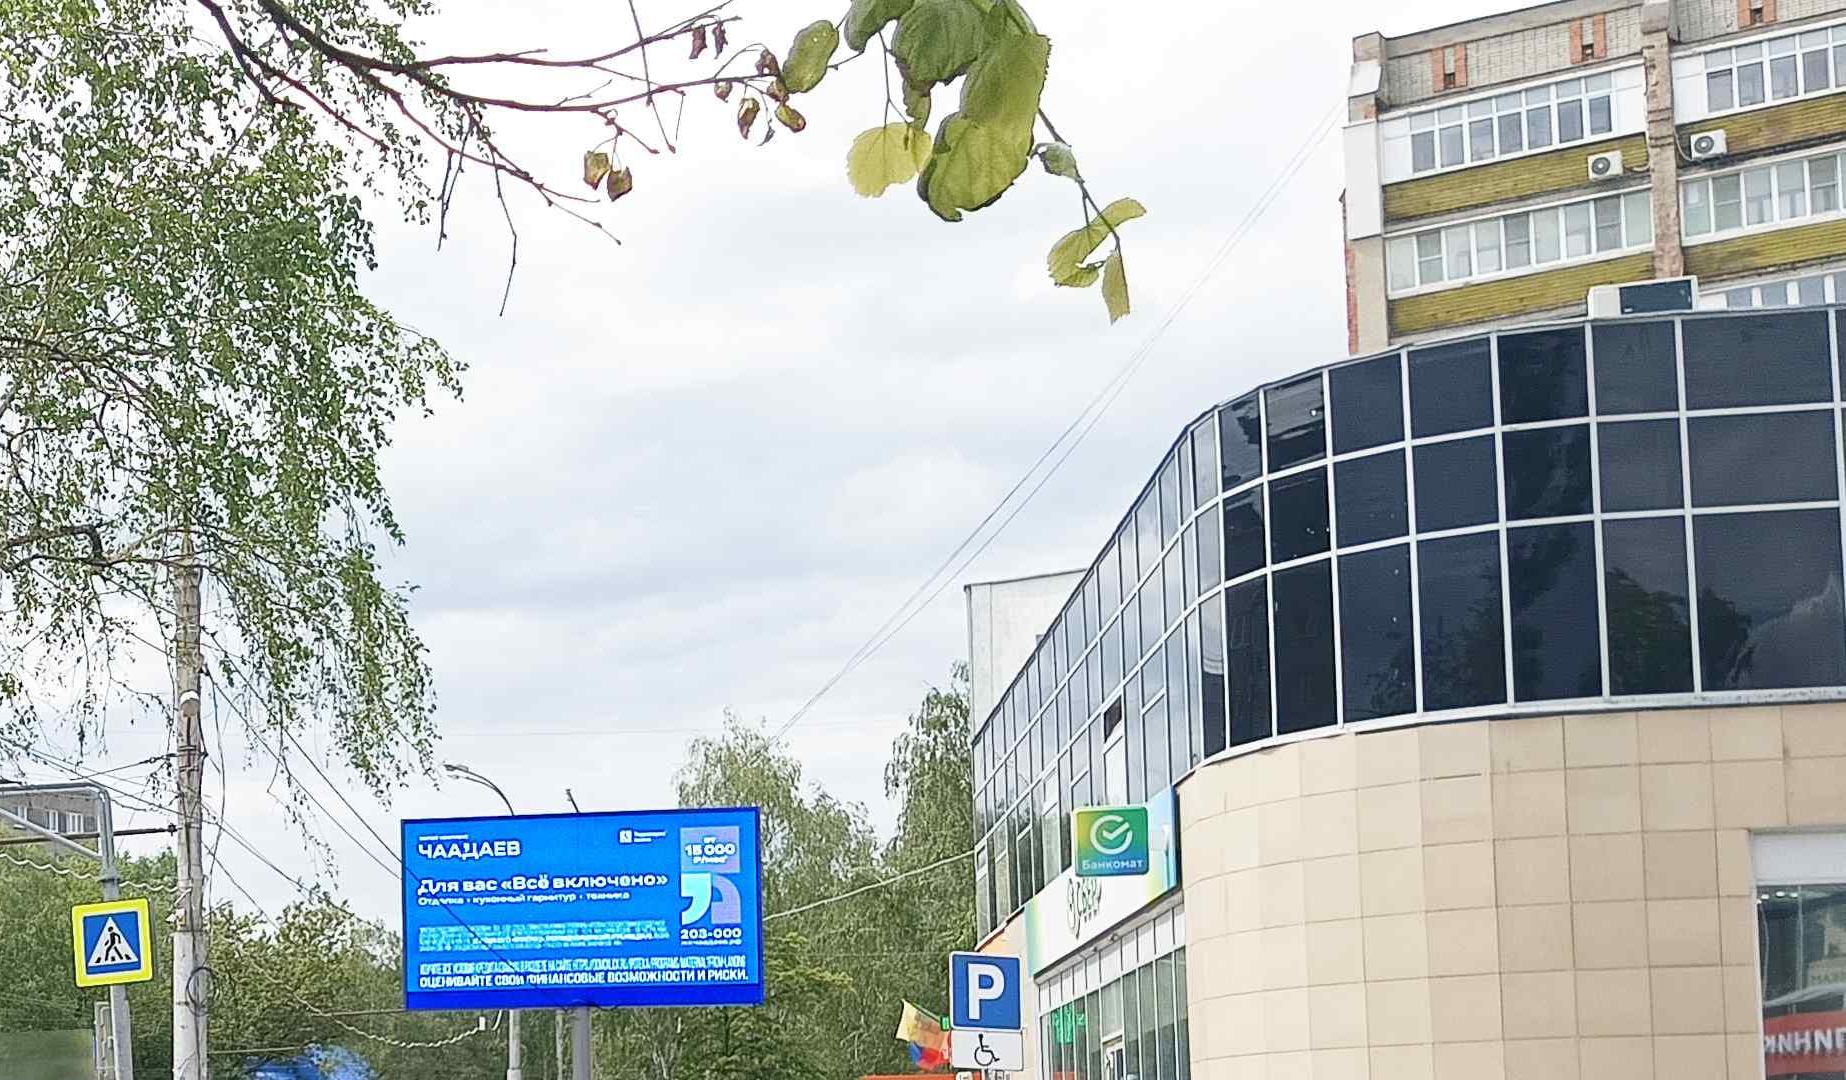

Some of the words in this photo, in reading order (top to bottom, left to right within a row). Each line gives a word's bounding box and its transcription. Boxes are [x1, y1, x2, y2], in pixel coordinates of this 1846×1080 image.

[418, 840, 521, 860] ЧААДАЕВ
[1081, 858, 1143, 871] Банкомат
[417, 879, 459, 896] Для
[462, 879, 498, 892] вас
[552, 874, 668, 889] включено»
[680, 927, 742, 939] 203-000
[419, 974, 493, 988] ОЦЕНИВАЙТЕ
[607, 969, 695, 983] ВОЗМОЖНОСТИ
[697, 969, 706, 981] И
[967, 963, 1006, 1020] P
